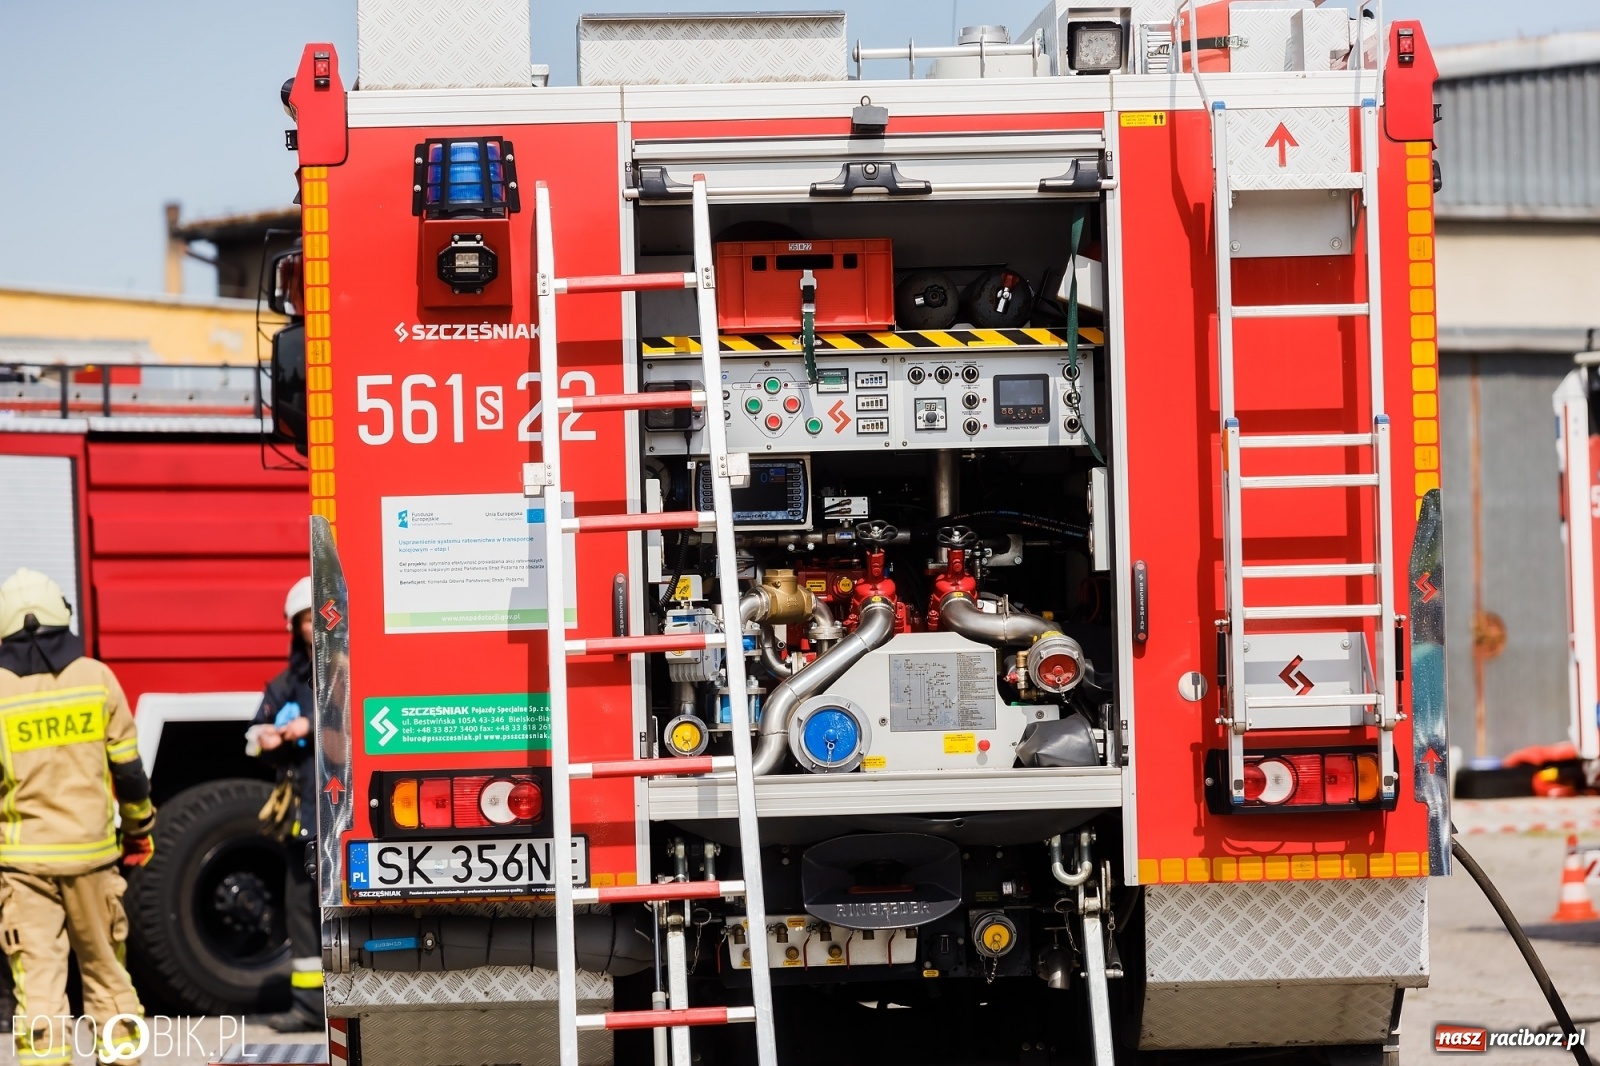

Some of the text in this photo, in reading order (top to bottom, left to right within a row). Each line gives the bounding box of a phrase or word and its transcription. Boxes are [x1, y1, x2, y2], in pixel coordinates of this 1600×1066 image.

[441, 613, 521, 622] www.mapadotacji.gov.pl
[401, 705, 470, 717] SZCZĘŚNIAK
[471, 706, 496, 715] Pojazdy
[497, 705, 528, 714] Specjalne
[528, 705, 539, 713] Sp.
[402, 718, 412, 726] ul.
[413, 717, 456, 725] Bestwińska
[458, 716, 477, 724] 105A
[402, 726, 415, 734] tel:
[443, 725, 458, 733] 827
[459, 725, 478, 733] 3400
[479, 724, 494, 732] fax:
[402, 731, 551, 743] biuro@psszczesniak.pl www.psszczesniak.
[376, 844, 434, 885] SK
[352, 872, 367, 883] PL
[836, 901, 931, 918] RINGFEDER
